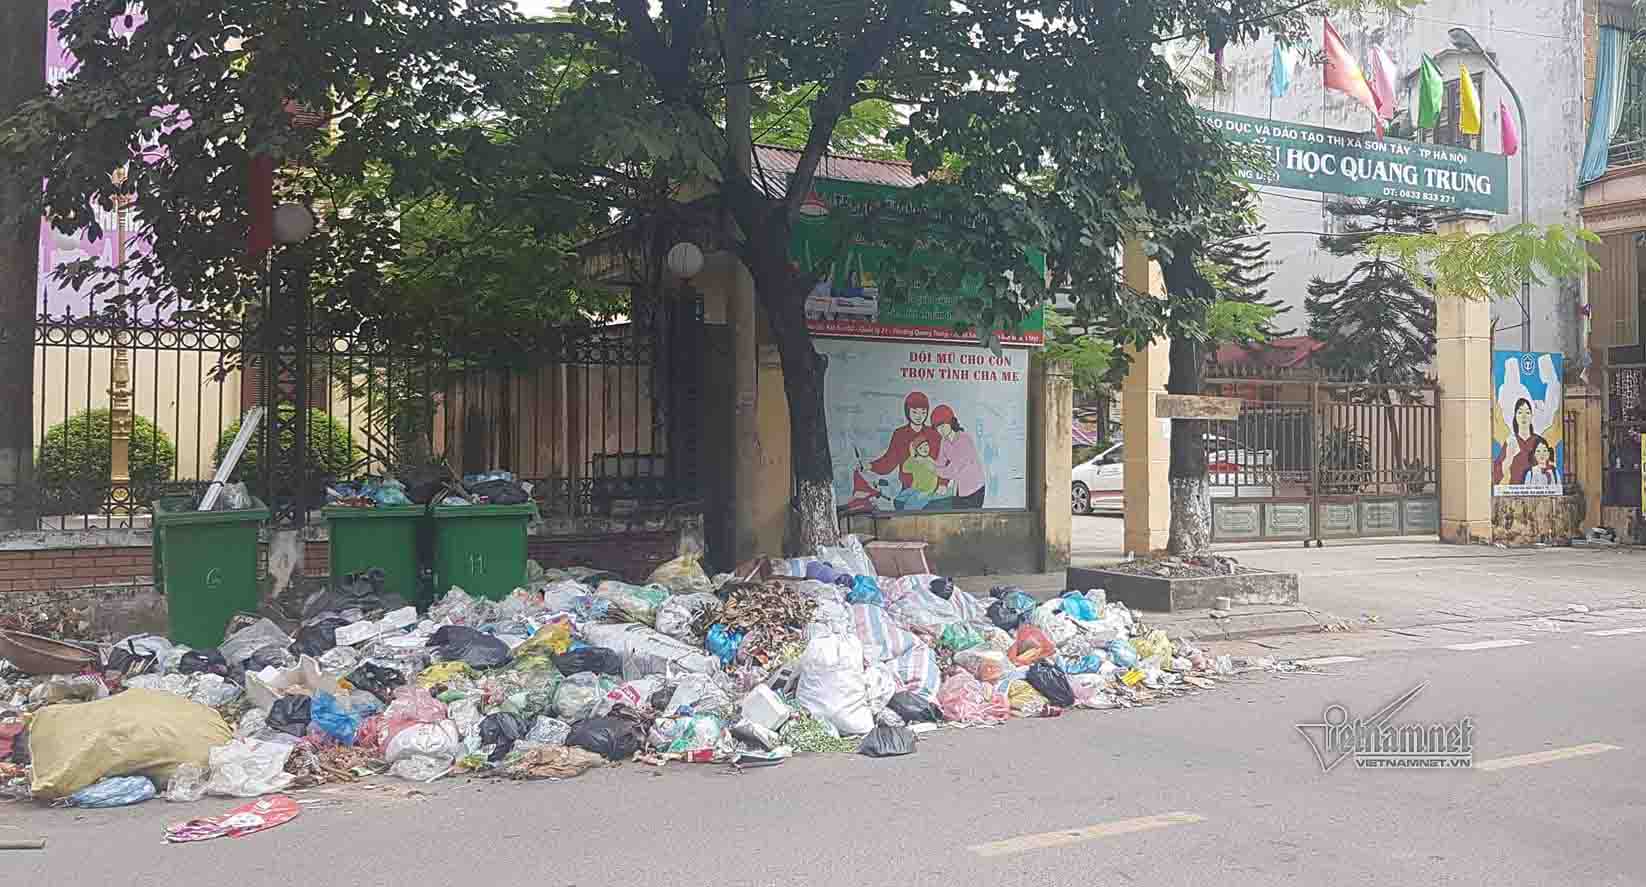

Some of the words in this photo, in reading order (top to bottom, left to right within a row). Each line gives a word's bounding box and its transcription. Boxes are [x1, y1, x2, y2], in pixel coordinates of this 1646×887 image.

[1419, 148, 1431, 160] TP
[1286, 148, 1337, 179] HỌC
[1340, 156, 1419, 186] QUANG
[1424, 167, 1492, 195] TRUNG
[960, 353, 985, 366] CHO
[988, 355, 1013, 367] CON
[973, 370, 998, 382] CHA
